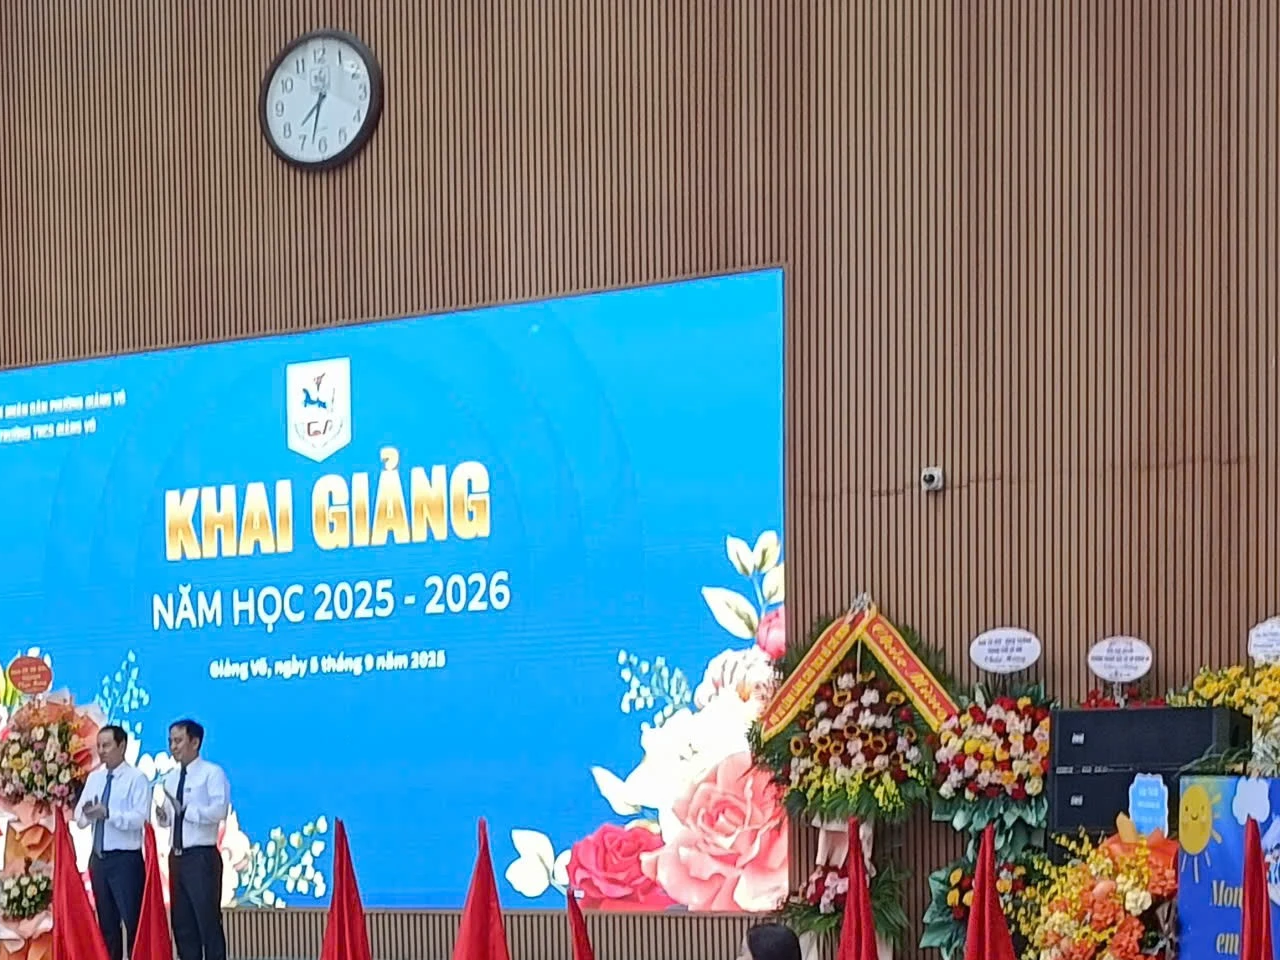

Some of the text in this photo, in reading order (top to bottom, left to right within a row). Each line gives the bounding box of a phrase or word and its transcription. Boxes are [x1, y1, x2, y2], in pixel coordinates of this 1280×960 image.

[313, 47, 326, 64] 12
[295, 58, 305, 74] 11
[281, 77, 294, 94] 10
[275, 101, 284, 117] 9
[299, 134, 307, 151] 7
[164, 446, 491, 562] KHAI GIẢNG
[152, 570, 511, 633] NĂM HỌC 2025 - 2026
[209, 657, 249, 681] Giảng
[250, 656, 272, 679] Võ,
[274, 653, 308, 679] ngày
[321, 651, 363, 676] tháng
[364, 653, 374, 672] 9
[375, 649, 408, 670] năm
[410, 649, 446, 669] 2025
